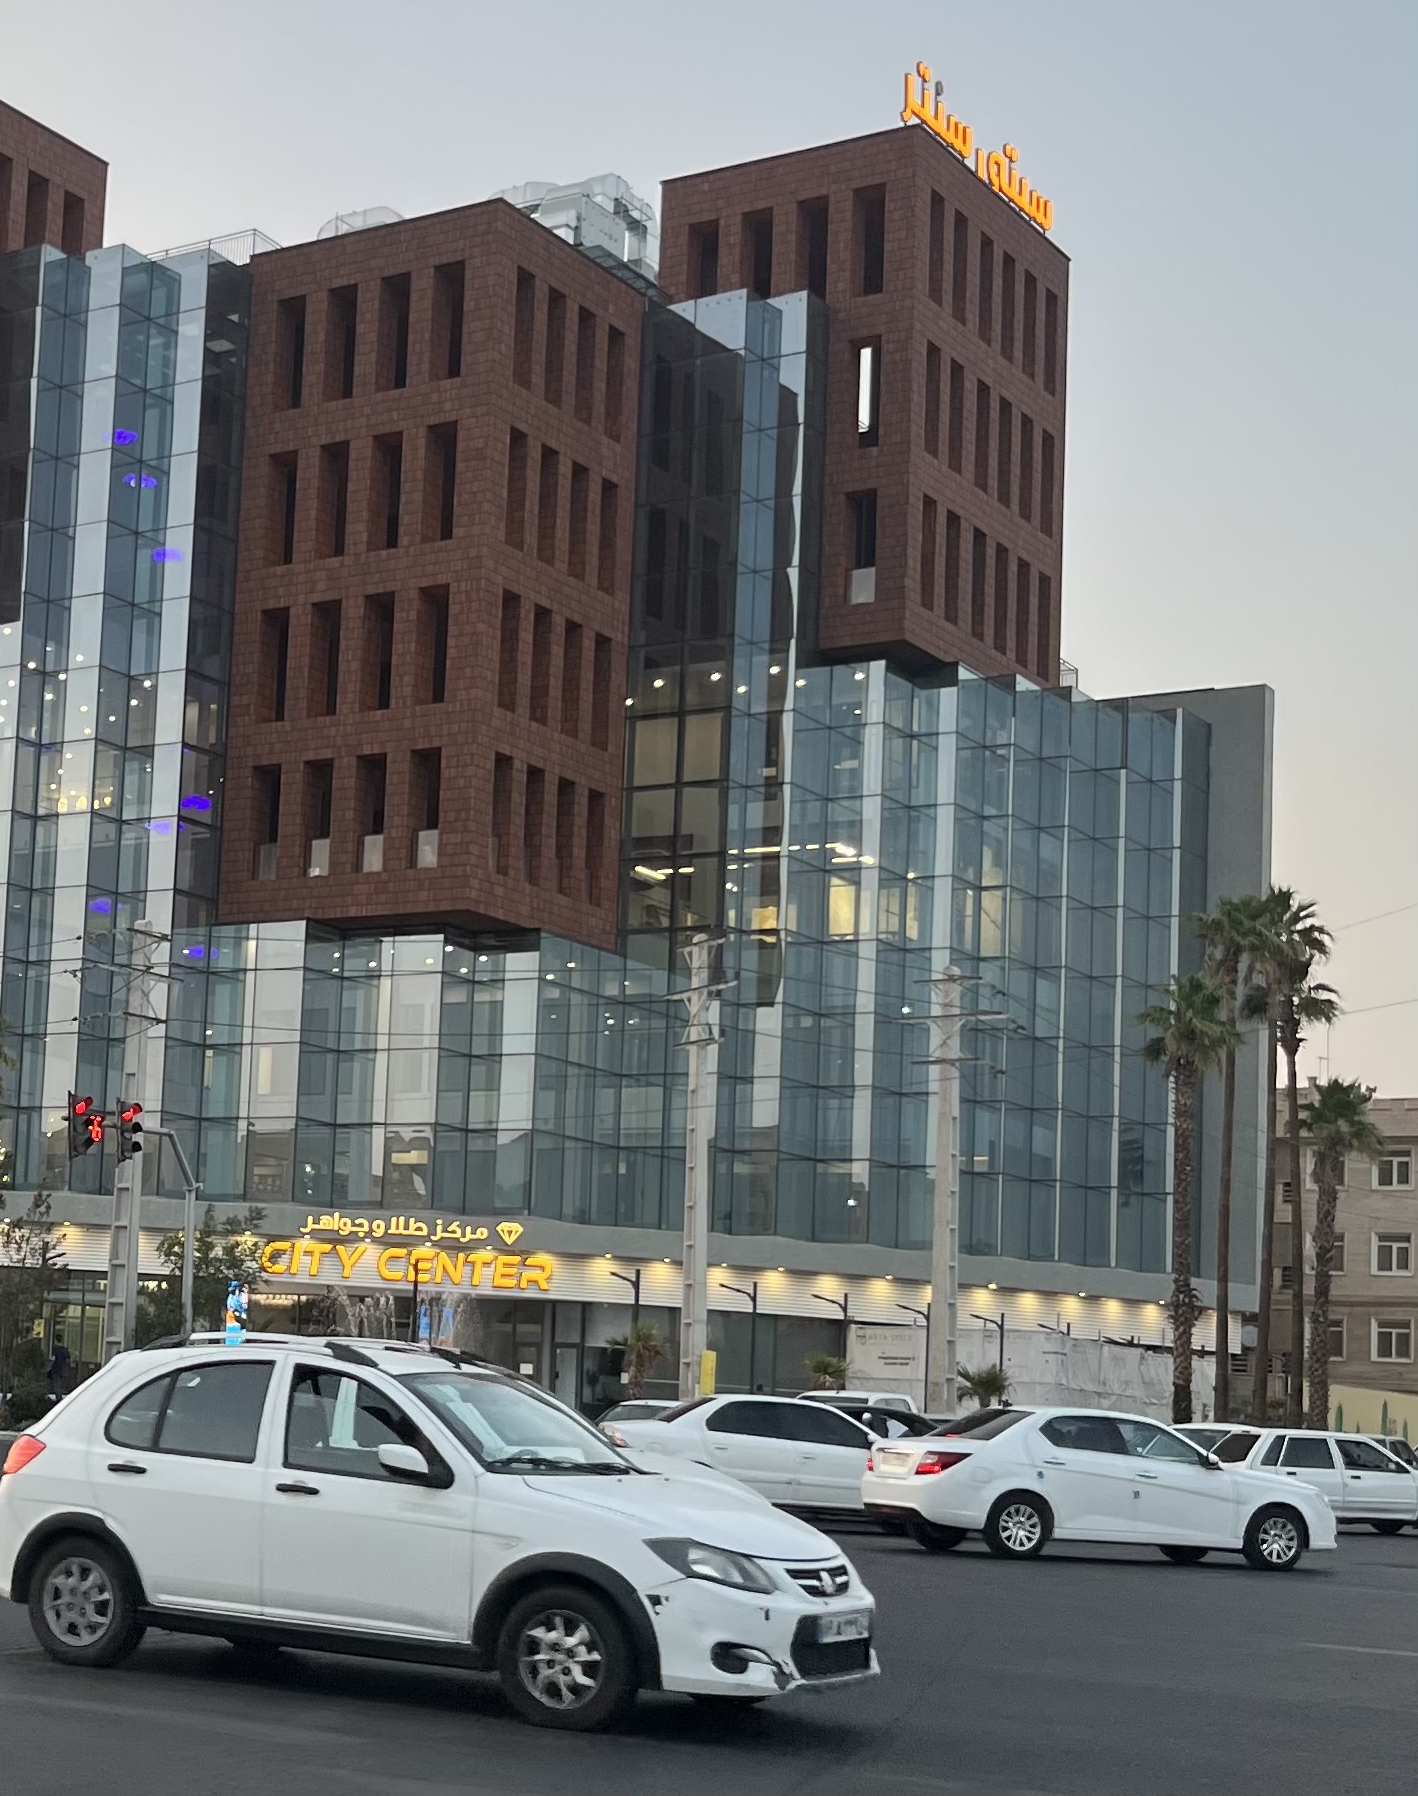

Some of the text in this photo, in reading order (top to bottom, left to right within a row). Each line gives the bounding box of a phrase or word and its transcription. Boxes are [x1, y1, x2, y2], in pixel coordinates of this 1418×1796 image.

[900, 60, 973, 159] سنتر
[299, 1211, 489, 1242] مرکز طلا و جواهر
[262, 1240, 553, 1291] CITY CENTER
